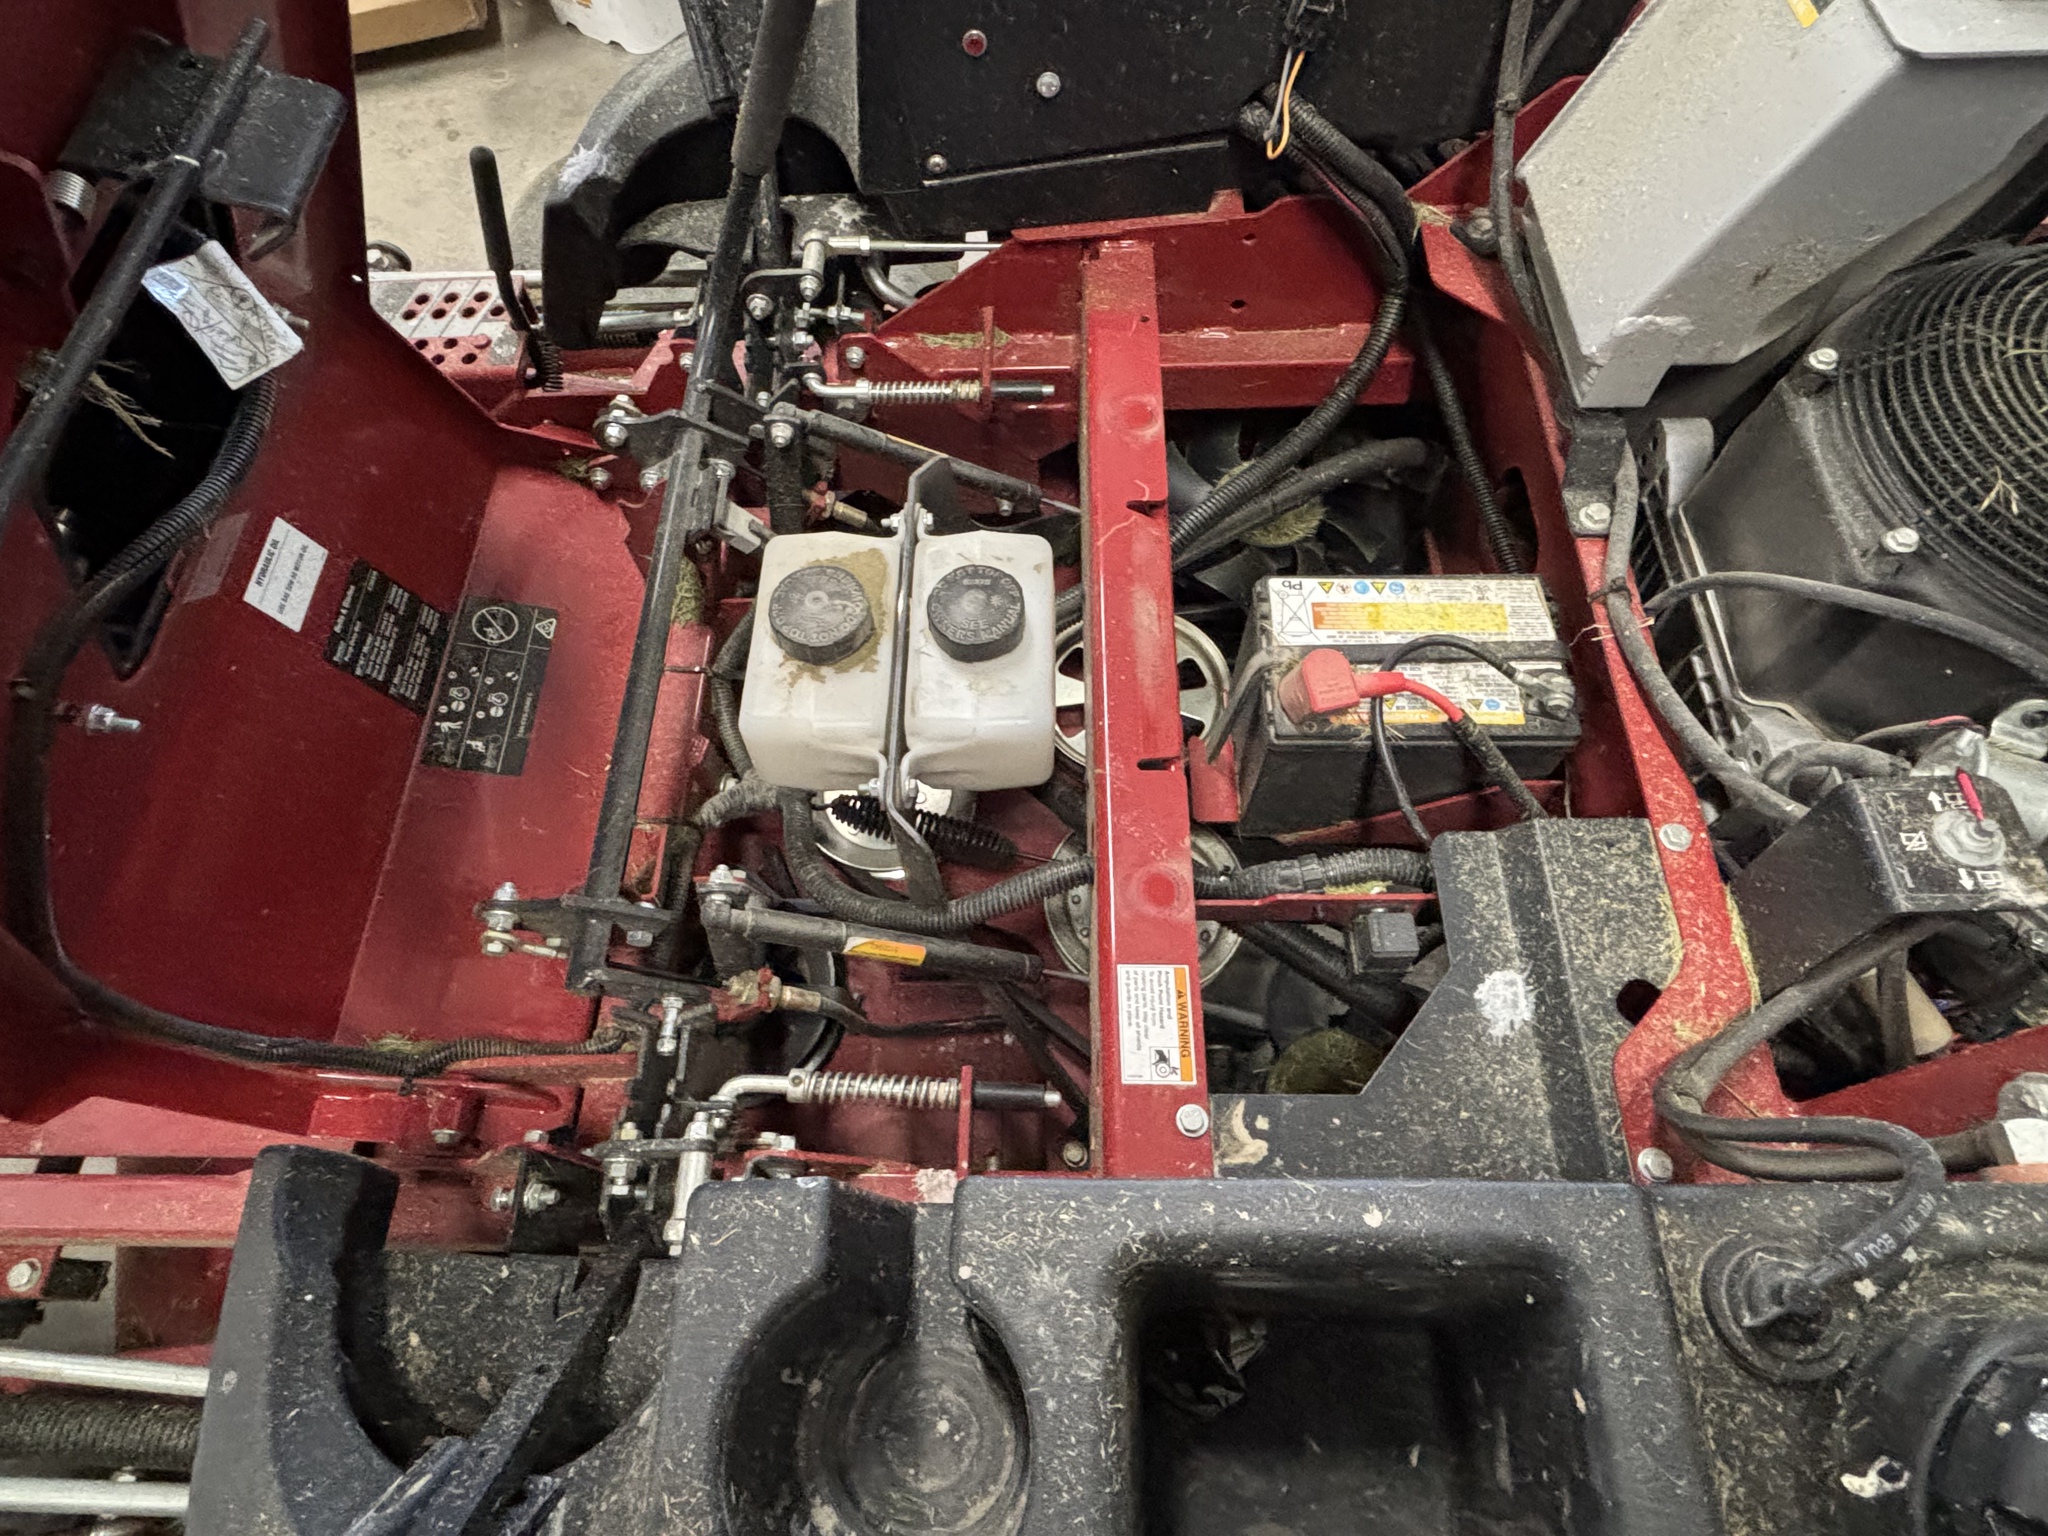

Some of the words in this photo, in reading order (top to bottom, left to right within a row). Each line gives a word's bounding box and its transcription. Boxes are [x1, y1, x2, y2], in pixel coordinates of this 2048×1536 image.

[255, 549, 277, 587] HYDRAULIC
[269, 539, 280, 550] OIL
[1281, 580, 1303, 590] Pb
[960, 618, 989, 630] SEE
[980, 602, 1021, 640] MANUAL
[1177, 1001, 1192, 1058] WARNING
